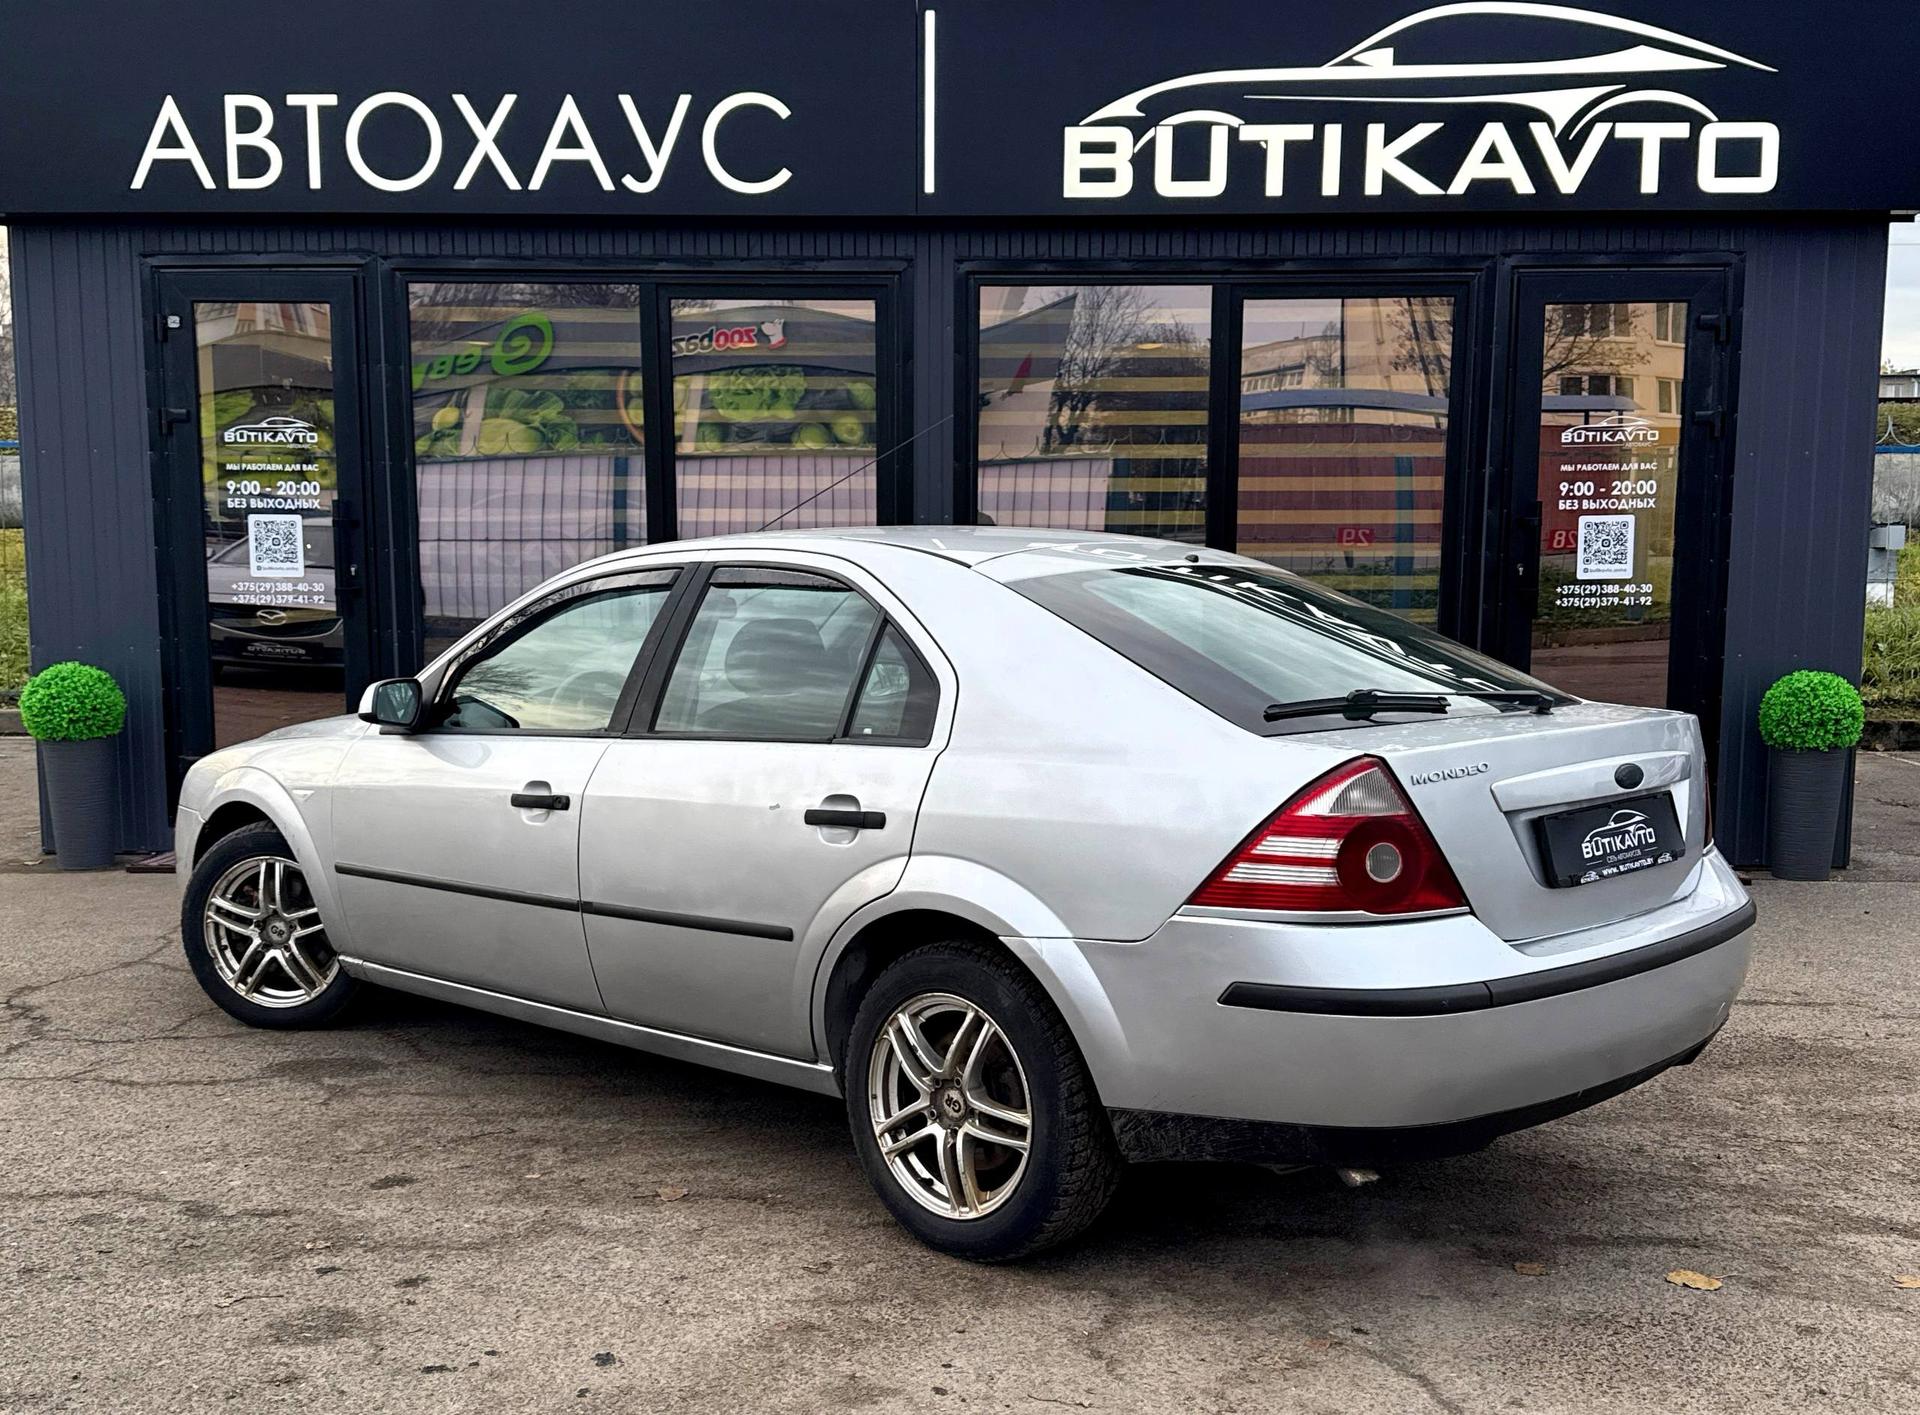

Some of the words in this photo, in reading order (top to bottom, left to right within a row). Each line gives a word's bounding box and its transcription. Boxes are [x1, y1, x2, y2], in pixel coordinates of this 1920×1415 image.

[130, 91, 793, 193] АВТОХАУС
[1062, 120, 1781, 199] BUTIKAVTO
[223, 430, 318, 443] BUTIKAVTO
[1561, 430, 1659, 443] BUTIKAVTO
[226, 463, 240, 471] МЫ
[241, 463, 283, 471] РАБОТАЕМ
[284, 463, 301, 472] ДЛЯ
[302, 464, 319, 472] ВАС
[1560, 464, 1575, 472] МЫ
[1576, 463, 1620, 471] РАБОТАЕМ
[1621, 463, 1638, 471] ДЛЯ
[1640, 462, 1658, 470] ВАС
[226, 480, 260, 495] 9:00
[276, 480, 320, 496] 20:00
[1559, 481, 1595, 496] 9:00
[1610, 480, 1657, 495] 20:00
[227, 498, 247, 509] БЕЗ
[250, 498, 321, 510] ВЫХОДНЫХ
[1558, 499, 1579, 510] БЕЗ
[1582, 498, 1656, 510] ВЫХОДНЫХ
[231, 582, 325, 594] +375(29)388-40-30
[1555, 583, 1653, 596] +375(29)388-40-30
[231, 594, 325, 605] +375(29)379-41-92
[1555, 596, 1652, 608] +375(29)379-41-92
[1410, 762, 1489, 786] MONDEO
[1581, 827, 1656, 859] BUTIKAVTO
